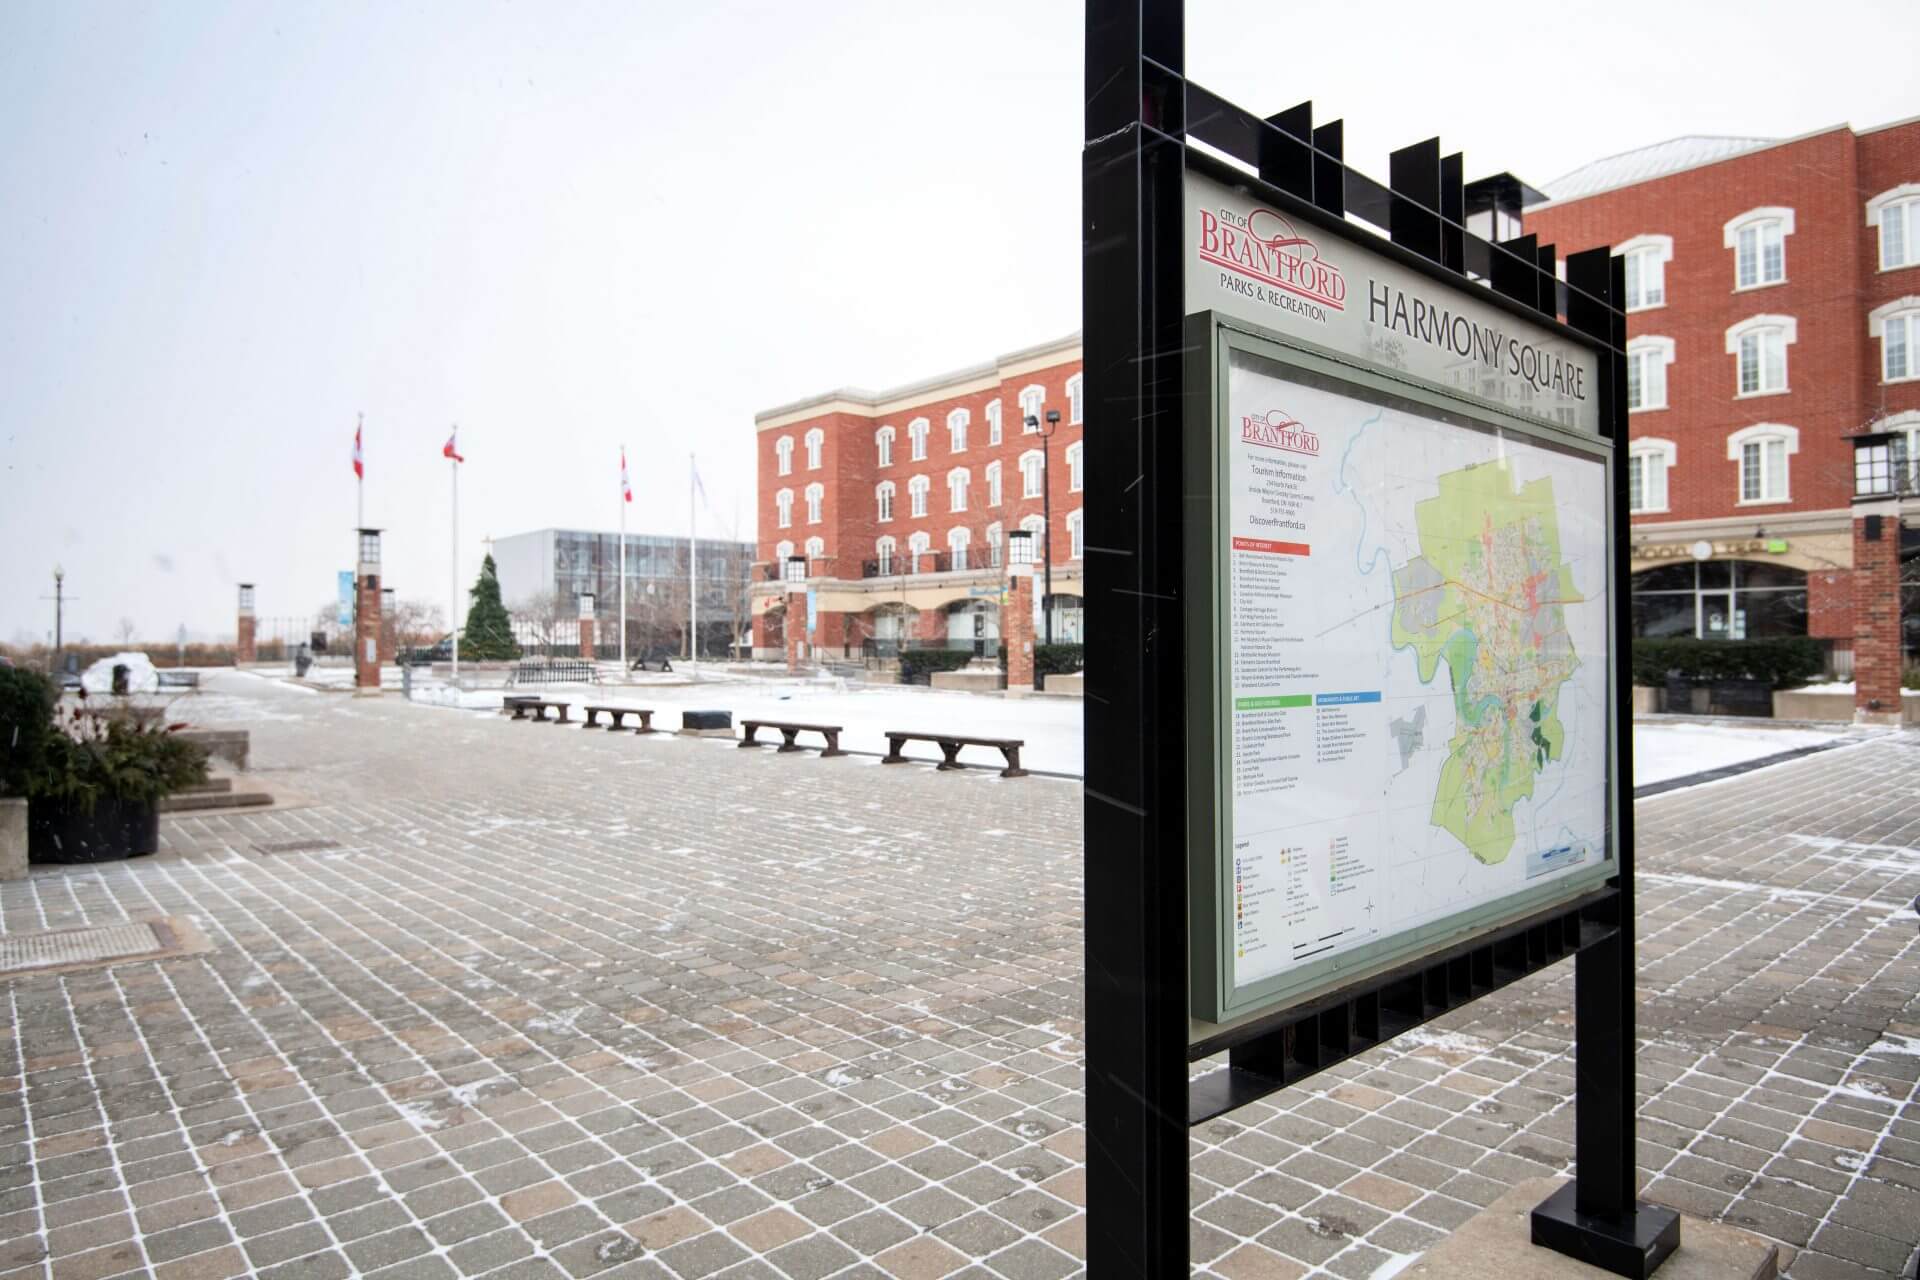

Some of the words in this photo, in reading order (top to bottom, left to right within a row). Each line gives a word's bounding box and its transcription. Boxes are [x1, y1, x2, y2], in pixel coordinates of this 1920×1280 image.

[1220, 209, 1236, 224] CITY
[1237, 216, 1247, 228] OF
[1200, 209, 1345, 301] BRANTFORD
[1220, 273, 1253, 297] PARKS
[1257, 286, 1265, 301] &
[1268, 290, 1326, 323] RECREATION
[1369, 279, 1502, 368] HARMONY
[1509, 338, 1585, 401] SQUARE
[1241, 416, 1319, 452] BRANTFORD
